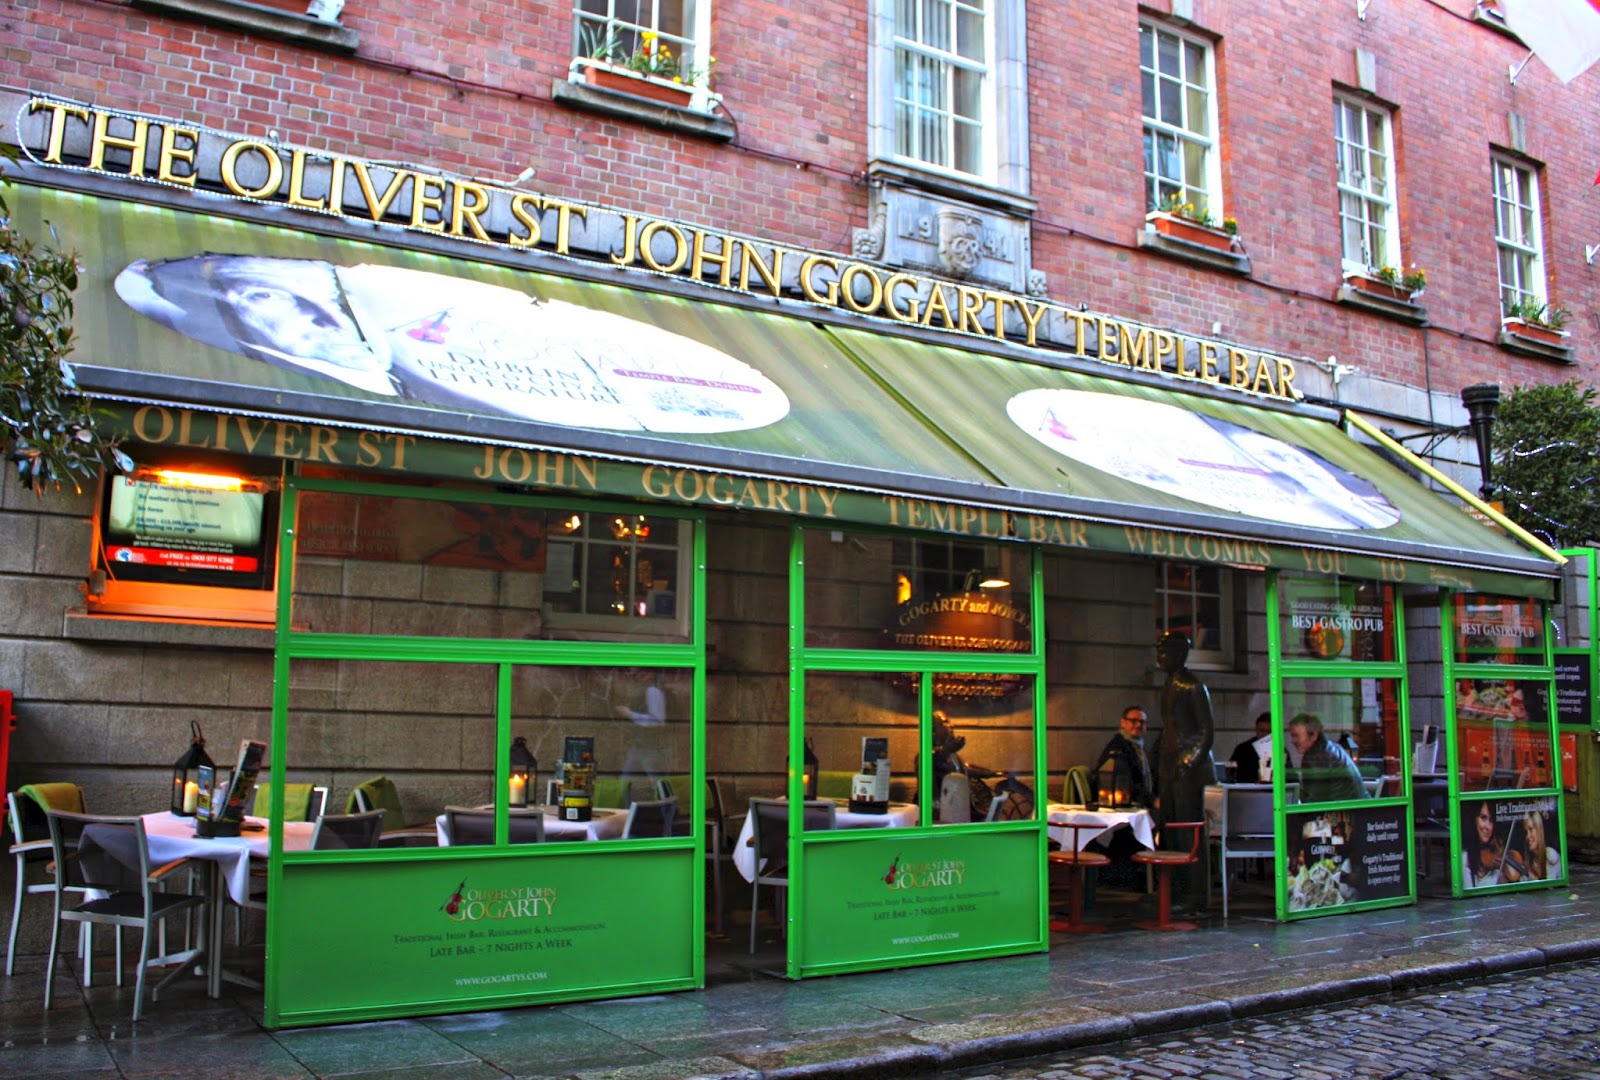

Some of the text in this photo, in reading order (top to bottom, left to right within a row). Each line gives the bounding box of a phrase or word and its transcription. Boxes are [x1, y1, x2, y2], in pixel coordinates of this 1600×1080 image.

[30, 96, 1300, 400] THE OLIVER ST JOHN GOGARTY TEMPLE BAR
[448, 352, 581, 382] DUBLIN
[132, 405, 342, 464] OLIVER
[356, 432, 417, 470] ST
[474, 445, 598, 490] JOHN
[641, 465, 843, 518] GOGARTY
[883, 496, 1020, 540] TEMPLE
[1029, 514, 1090, 548] BAR
[1123, 525, 1273, 567] WELCOMES
[1301, 548, 1349, 575] YOU
[1377, 557, 1407, 583] TO
[898, 596, 969, 627] GOGARTY
[969, 600, 989, 613] and
[1291, 614, 1384, 632] BEST GASTRO PUB
[1461, 622, 1482, 636] BEST
[1482, 623, 1519, 638] GASTRO
[1559, 688, 1587, 697] Traditional
[1496, 803, 1508, 815] Live
[1508, 801, 1537, 814] Traditional
[1382, 851, 1404, 862] Traditional
[1377, 864, 1400, 873] Restaurant
[888, 868, 967, 891] GOGARTY
[467, 886, 557, 902] OLIVER ST JOHN
[449, 896, 558, 923] GOGARTY
[873, 910, 892, 921] LATE
[892, 909, 907, 919] BAR
[921, 905, 949, 917] NIGHTS
[430, 947, 452, 959] LATE
[456, 945, 476, 956] BAR
[495, 941, 534, 953] NIGHTS
[545, 938, 573, 949] WEEK
[455, 971, 548, 987] WWW.GOGARTYS.COM
